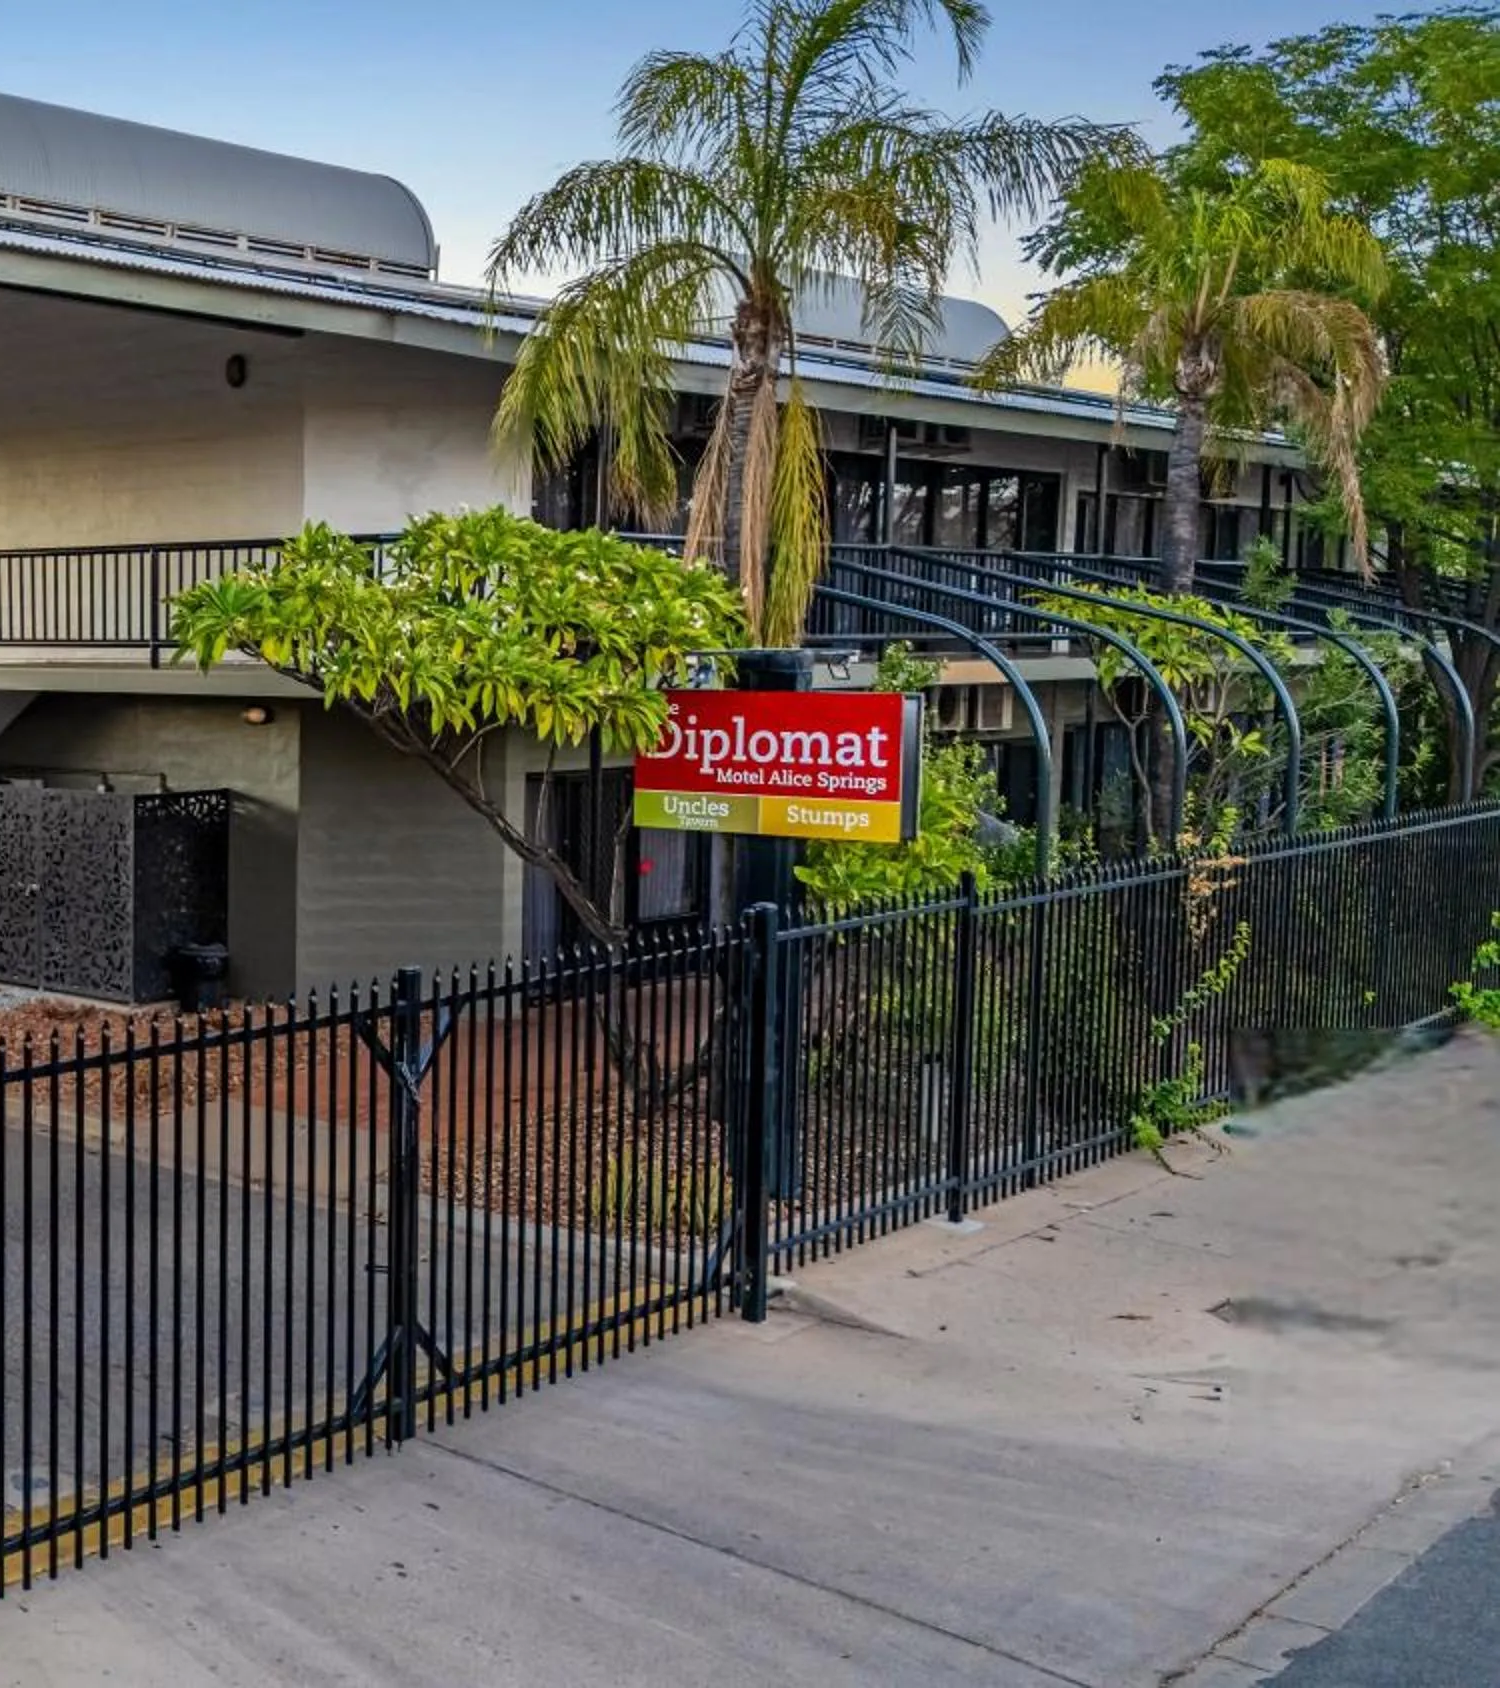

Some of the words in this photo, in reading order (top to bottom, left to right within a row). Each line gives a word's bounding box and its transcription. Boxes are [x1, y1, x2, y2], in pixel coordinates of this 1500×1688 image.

[716, 767, 765, 785] Motel
[768, 769, 812, 787] Alice
[816, 771, 887, 795] Springs
[663, 795, 729, 817] Uncles
[787, 804, 869, 832] Stumps
